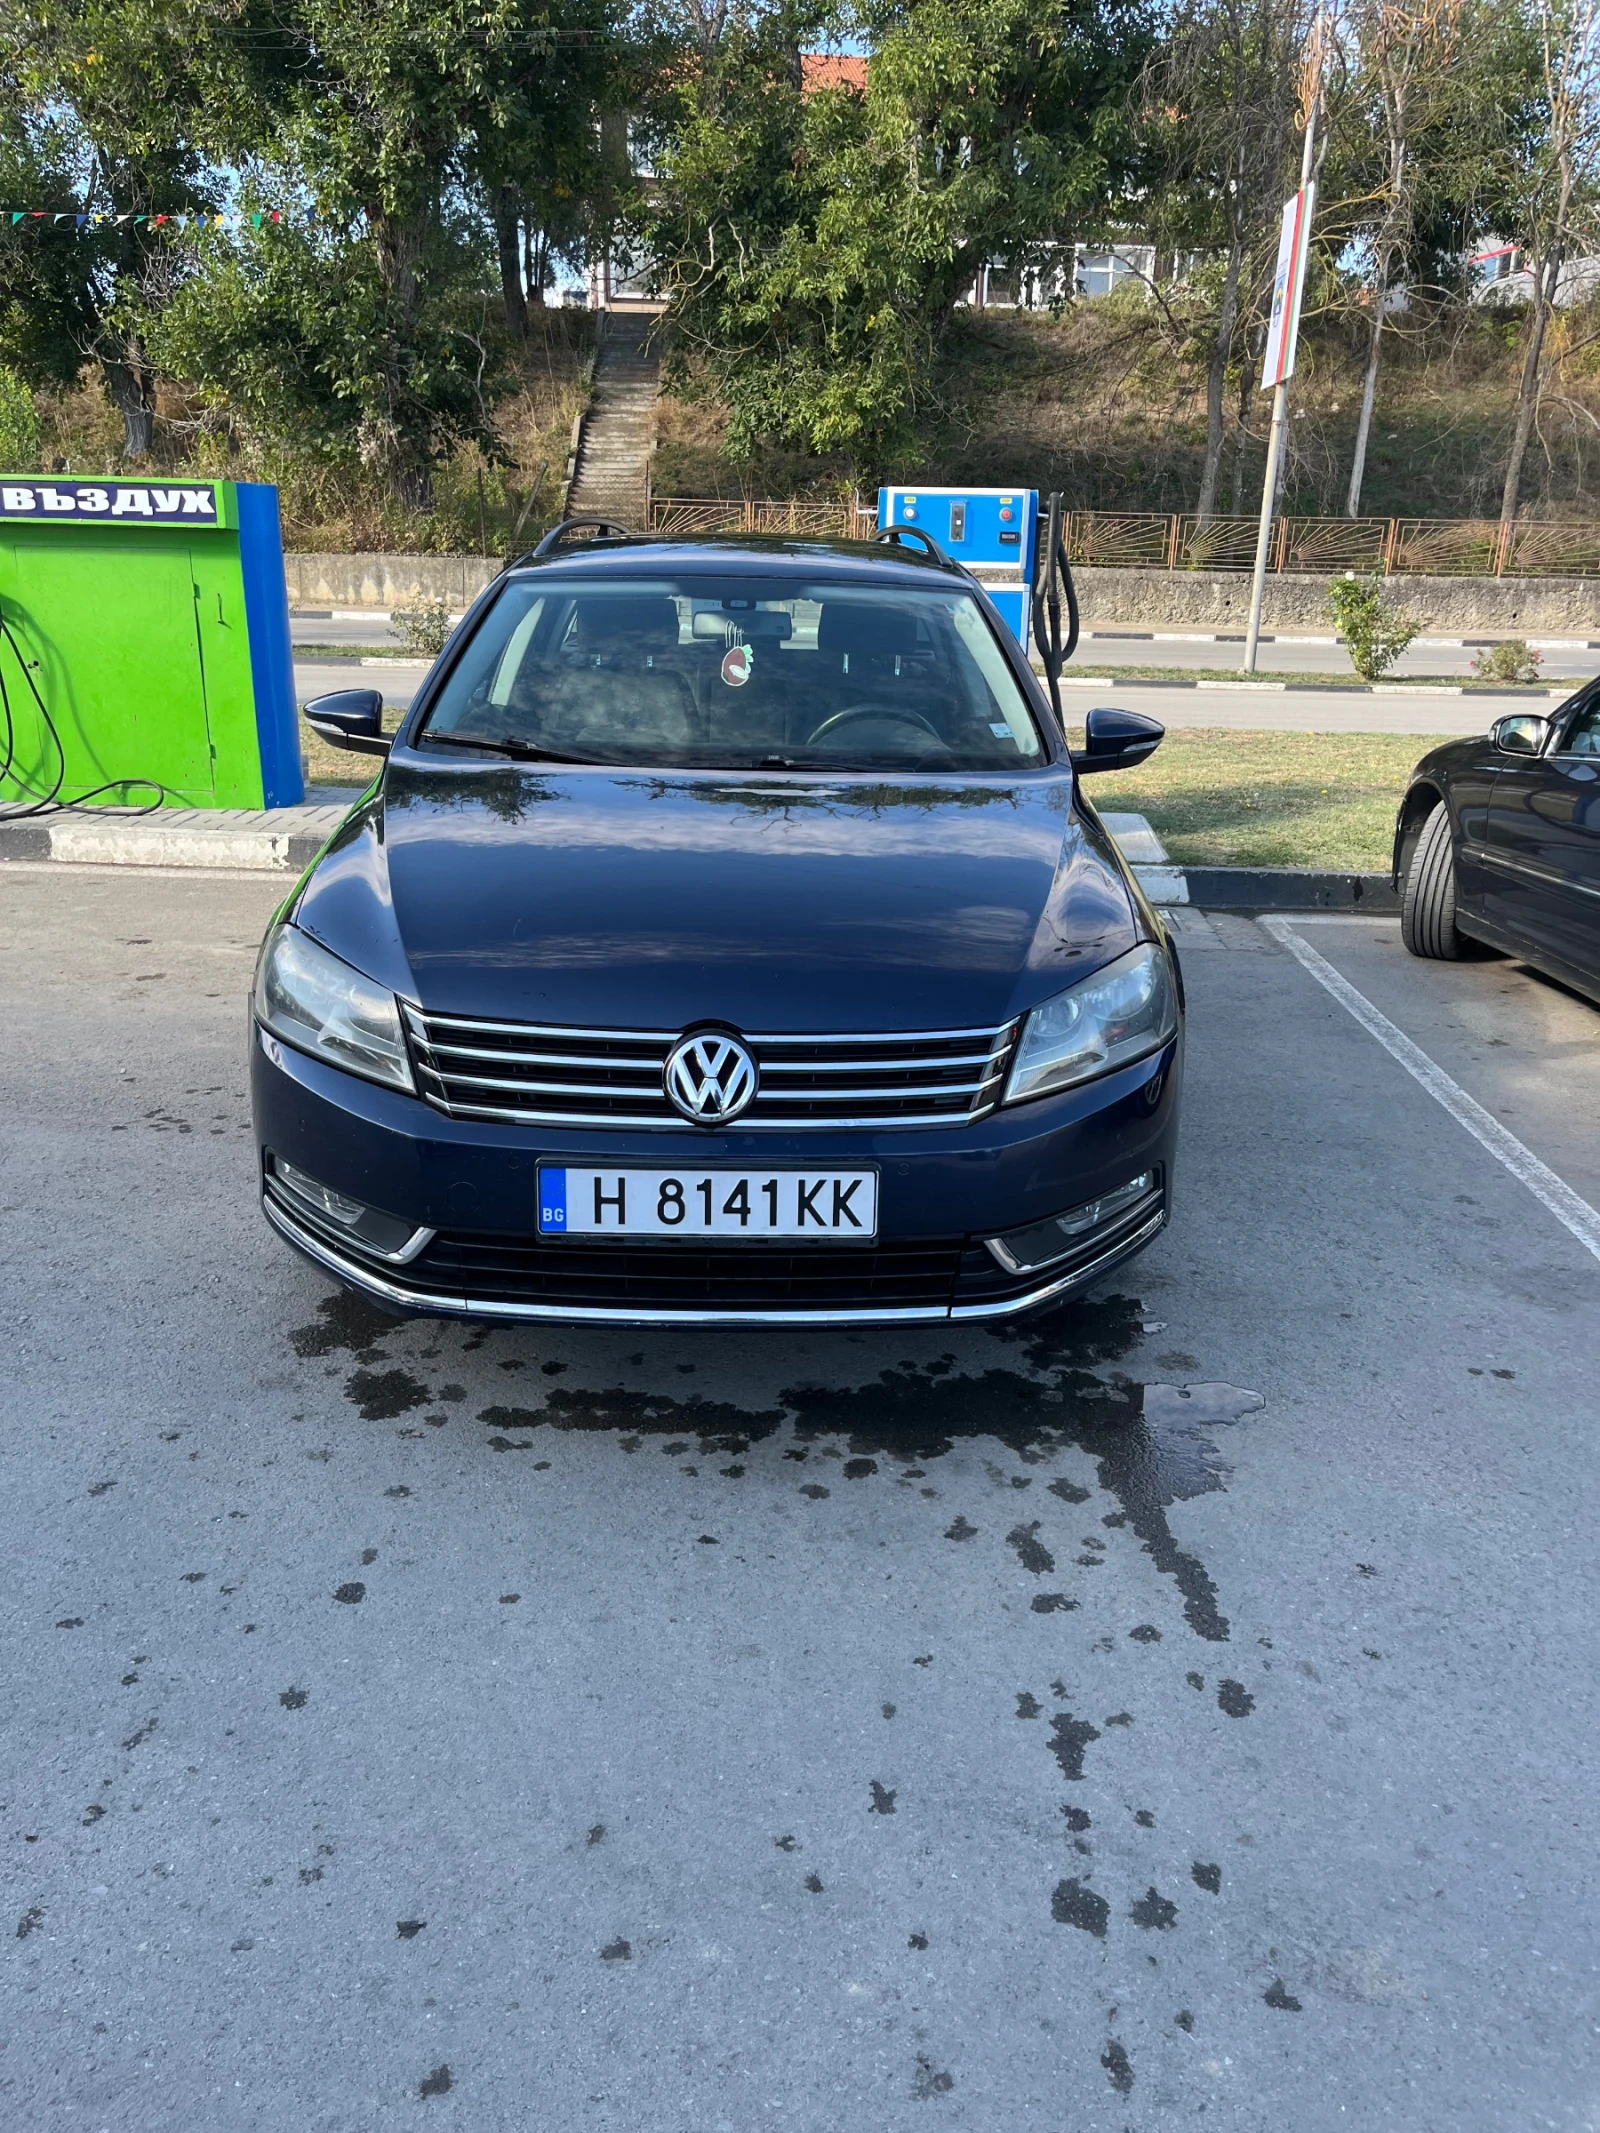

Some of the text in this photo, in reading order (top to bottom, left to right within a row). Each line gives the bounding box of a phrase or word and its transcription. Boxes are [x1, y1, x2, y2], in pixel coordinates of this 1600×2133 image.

[2, 487, 216, 516] ВЪЗДУХ
[666, 1033, 757, 1122] VW
[542, 1207, 564, 1222] BG
[594, 1176, 626, 1225] H
